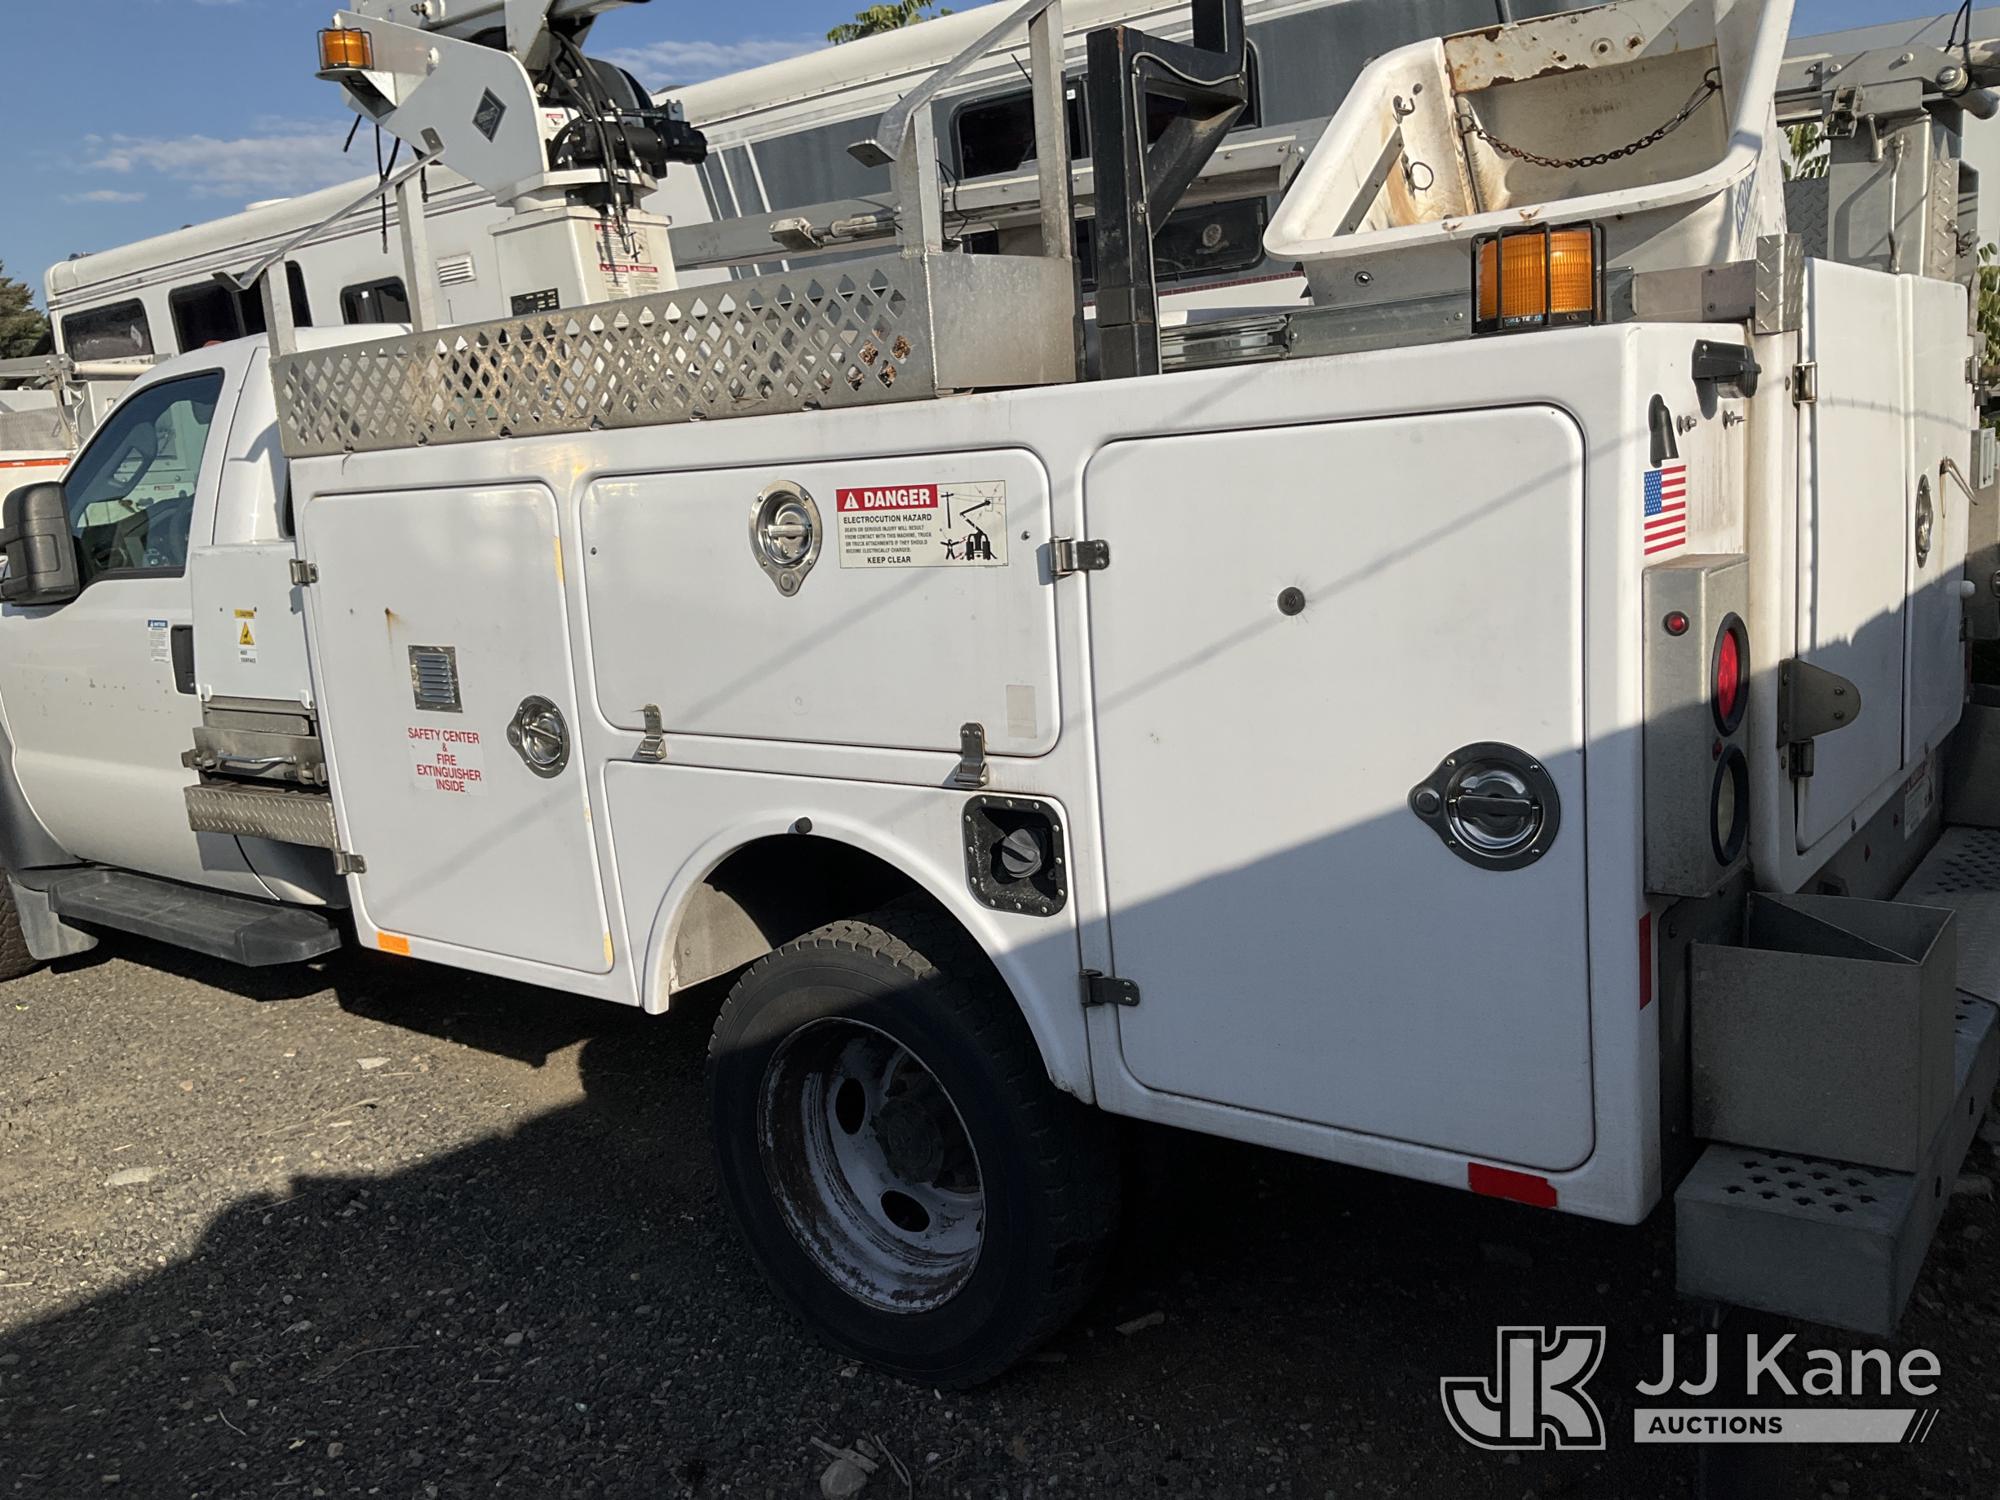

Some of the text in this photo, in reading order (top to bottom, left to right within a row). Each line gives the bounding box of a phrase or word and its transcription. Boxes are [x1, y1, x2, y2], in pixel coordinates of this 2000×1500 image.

[864, 488, 930, 507] DANGER
[844, 515, 900, 524] ELECTROCUTION
[408, 728, 480, 744] SAFETY CENTER
[443, 742, 447, 752] &
[437, 754, 456, 766] FIRE
[417, 764, 482, 781] EXTINGUISHER
[436, 779, 466, 792] INSIDE
